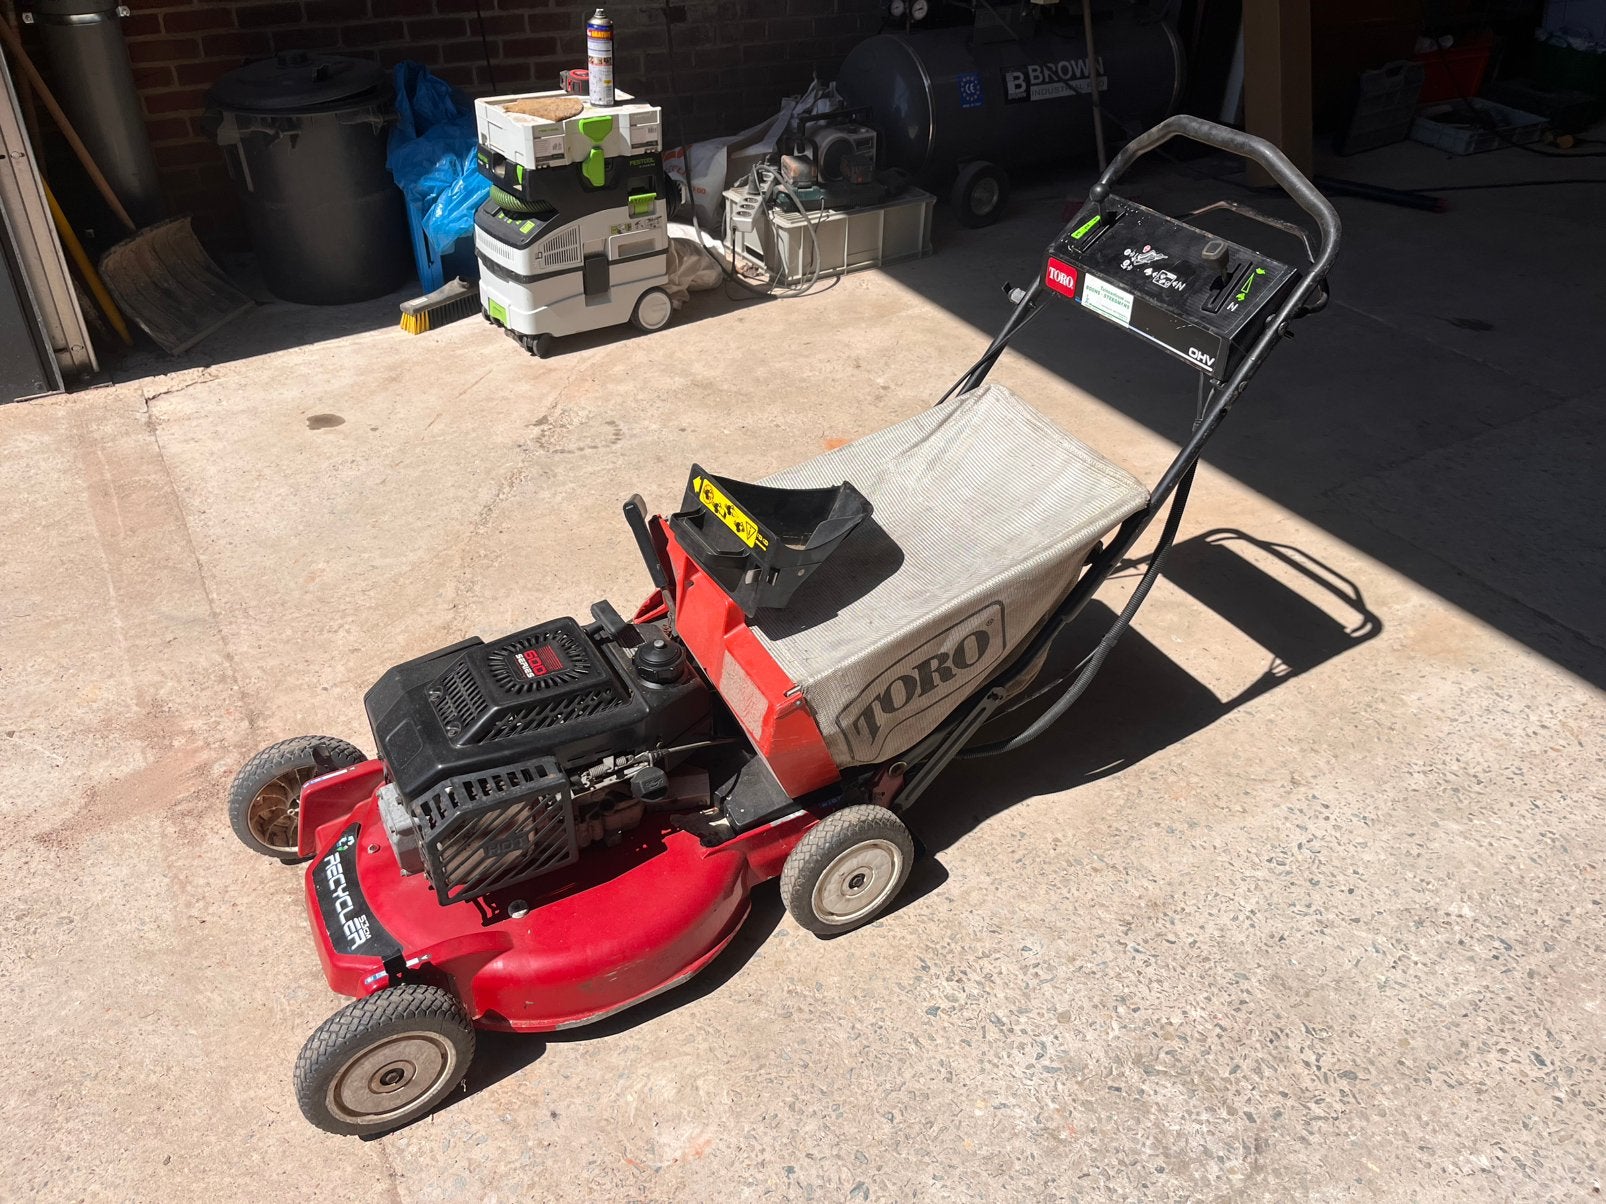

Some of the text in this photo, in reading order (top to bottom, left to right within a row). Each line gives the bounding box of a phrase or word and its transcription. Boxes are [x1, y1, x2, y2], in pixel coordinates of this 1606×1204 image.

[1028, 56, 1104, 83] BROWN
[1049, 266, 1074, 288] TORO
[1226, 301, 1239, 312] N
[1188, 346, 1215, 366] OHV
[515, 653, 535, 678] SERIES
[523, 649, 548, 676] 600
[852, 628, 991, 747] TORO
[323, 851, 367, 951] RECYCLER
